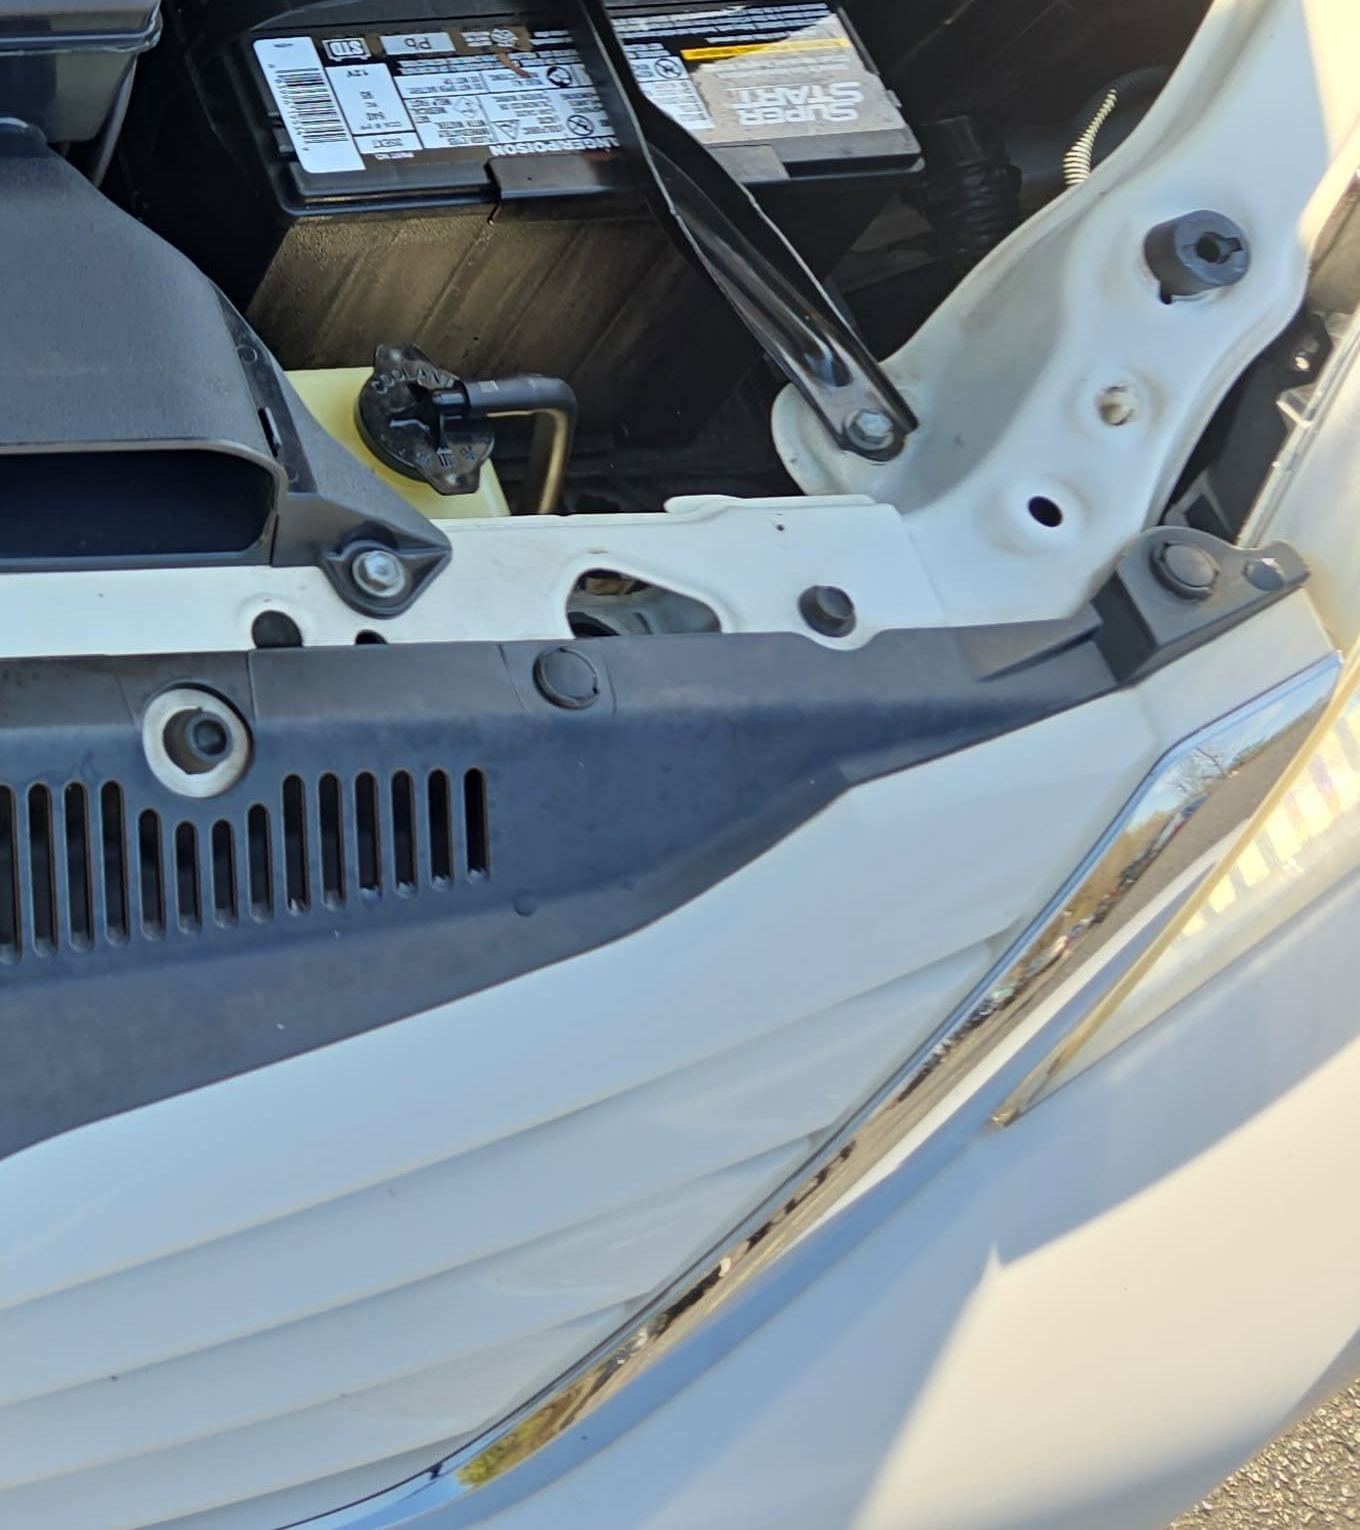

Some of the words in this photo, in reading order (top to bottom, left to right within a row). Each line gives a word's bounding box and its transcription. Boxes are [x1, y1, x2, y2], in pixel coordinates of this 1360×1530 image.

[404, 38, 432, 50] Pb
[728, 81, 865, 109] START
[737, 102, 859, 126] SUPER
